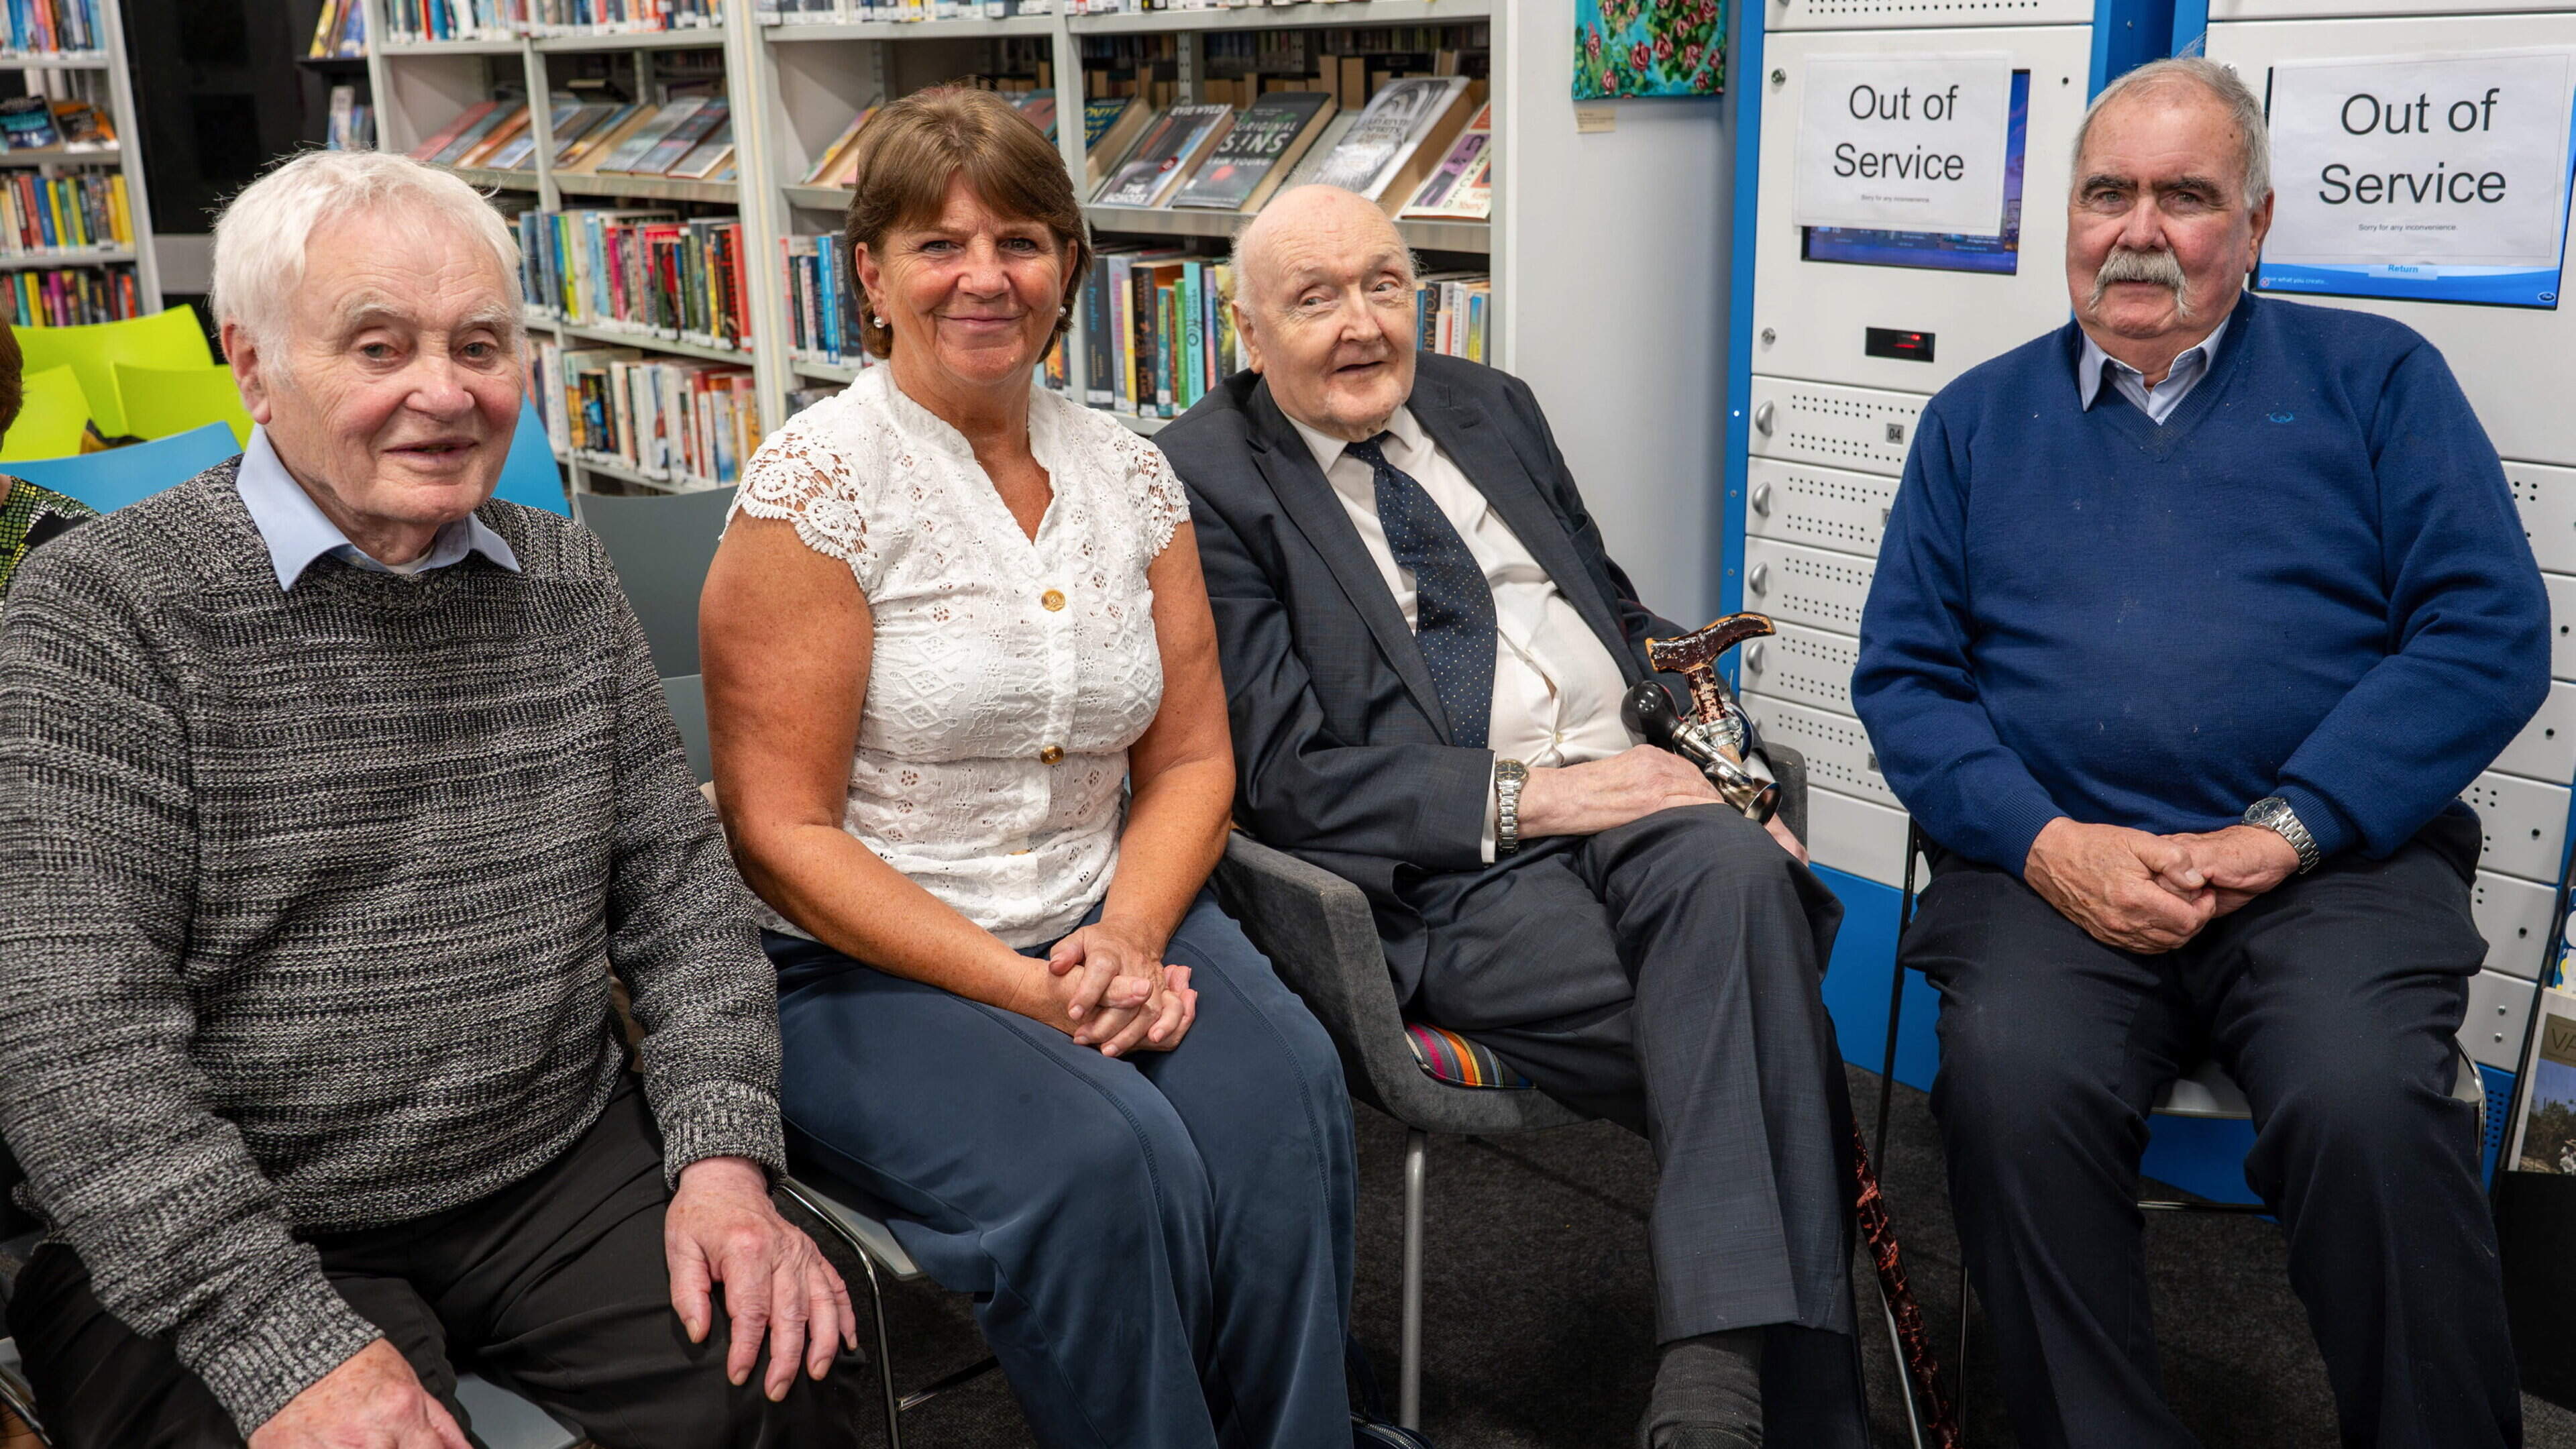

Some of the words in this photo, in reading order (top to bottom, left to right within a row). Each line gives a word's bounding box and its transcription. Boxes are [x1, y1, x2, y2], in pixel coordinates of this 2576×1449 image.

[1849, 85, 1911, 121] Out
[1923, 85, 1959, 121] of
[2341, 93, 2430, 135] Out
[2448, 88, 2500, 132] of
[1235, 121, 1298, 132] ORIGINAL
[1833, 143, 1964, 181] Service
[2318, 162, 2506, 205] Service
[2358, 223, 2377, 232] Sorry
[2379, 223, 2389, 231] for
[2387, 264, 2418, 274] Return
[1888, 427, 1900, 441] 04
